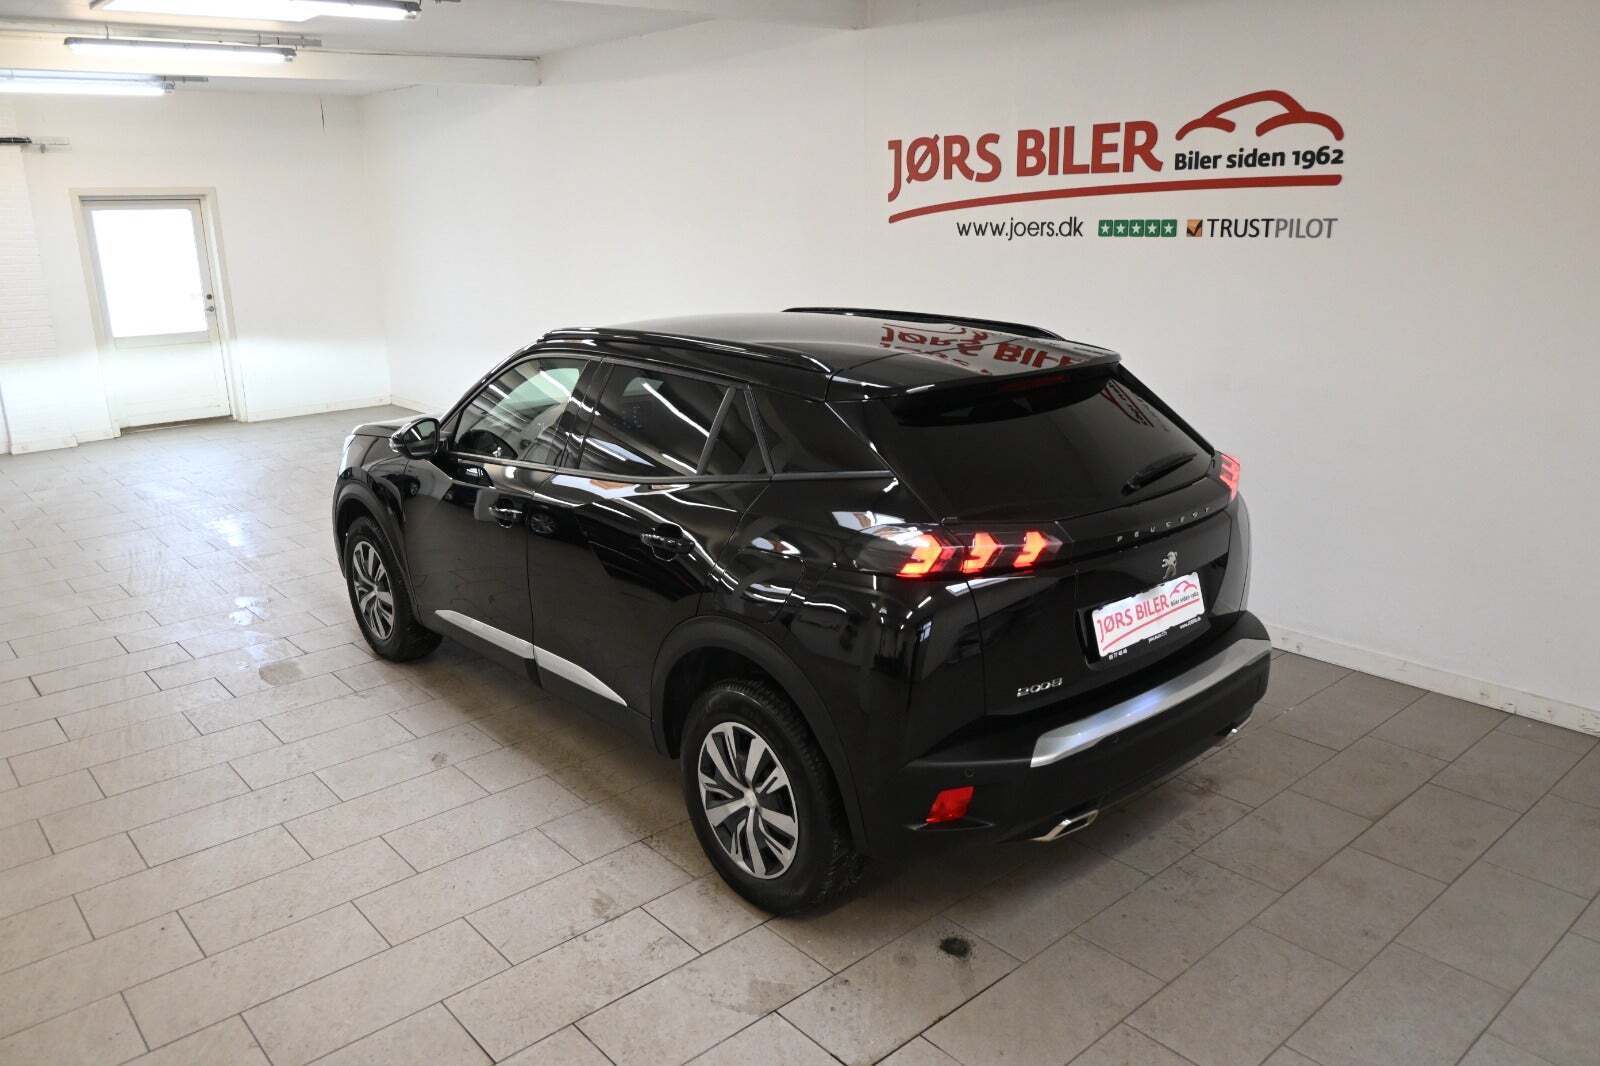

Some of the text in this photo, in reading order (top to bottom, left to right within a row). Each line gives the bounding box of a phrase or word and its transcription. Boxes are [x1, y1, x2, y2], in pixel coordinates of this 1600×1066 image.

[887, 120, 1164, 203] JØRS BILER
[1174, 145, 1345, 171] Biler siden 1962
[956, 216, 1084, 241] www.joers.dk
[1206, 217, 1339, 239] TRUSTPILOT
[1096, 608, 1134, 644] JØRS
[1134, 594, 1170, 621] BILER
